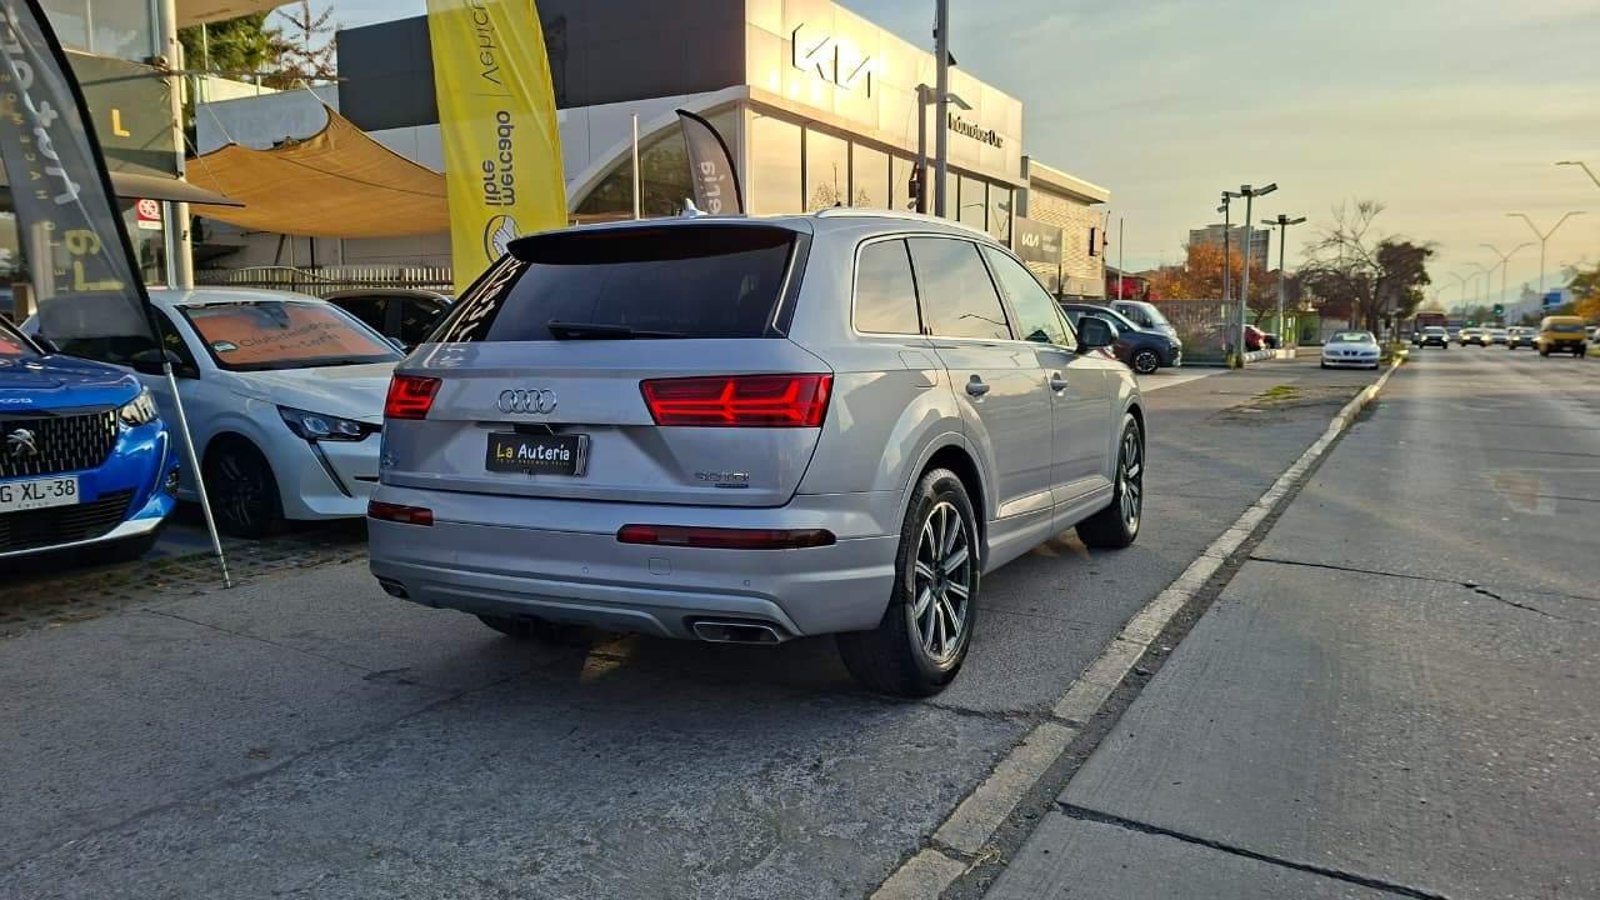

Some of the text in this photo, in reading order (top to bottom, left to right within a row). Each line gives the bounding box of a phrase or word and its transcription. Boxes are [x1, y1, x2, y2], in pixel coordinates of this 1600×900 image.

[792, 23, 871, 98] KIA
[1021, 232, 1040, 248] KIA
[496, 442, 570, 461] La Autería
